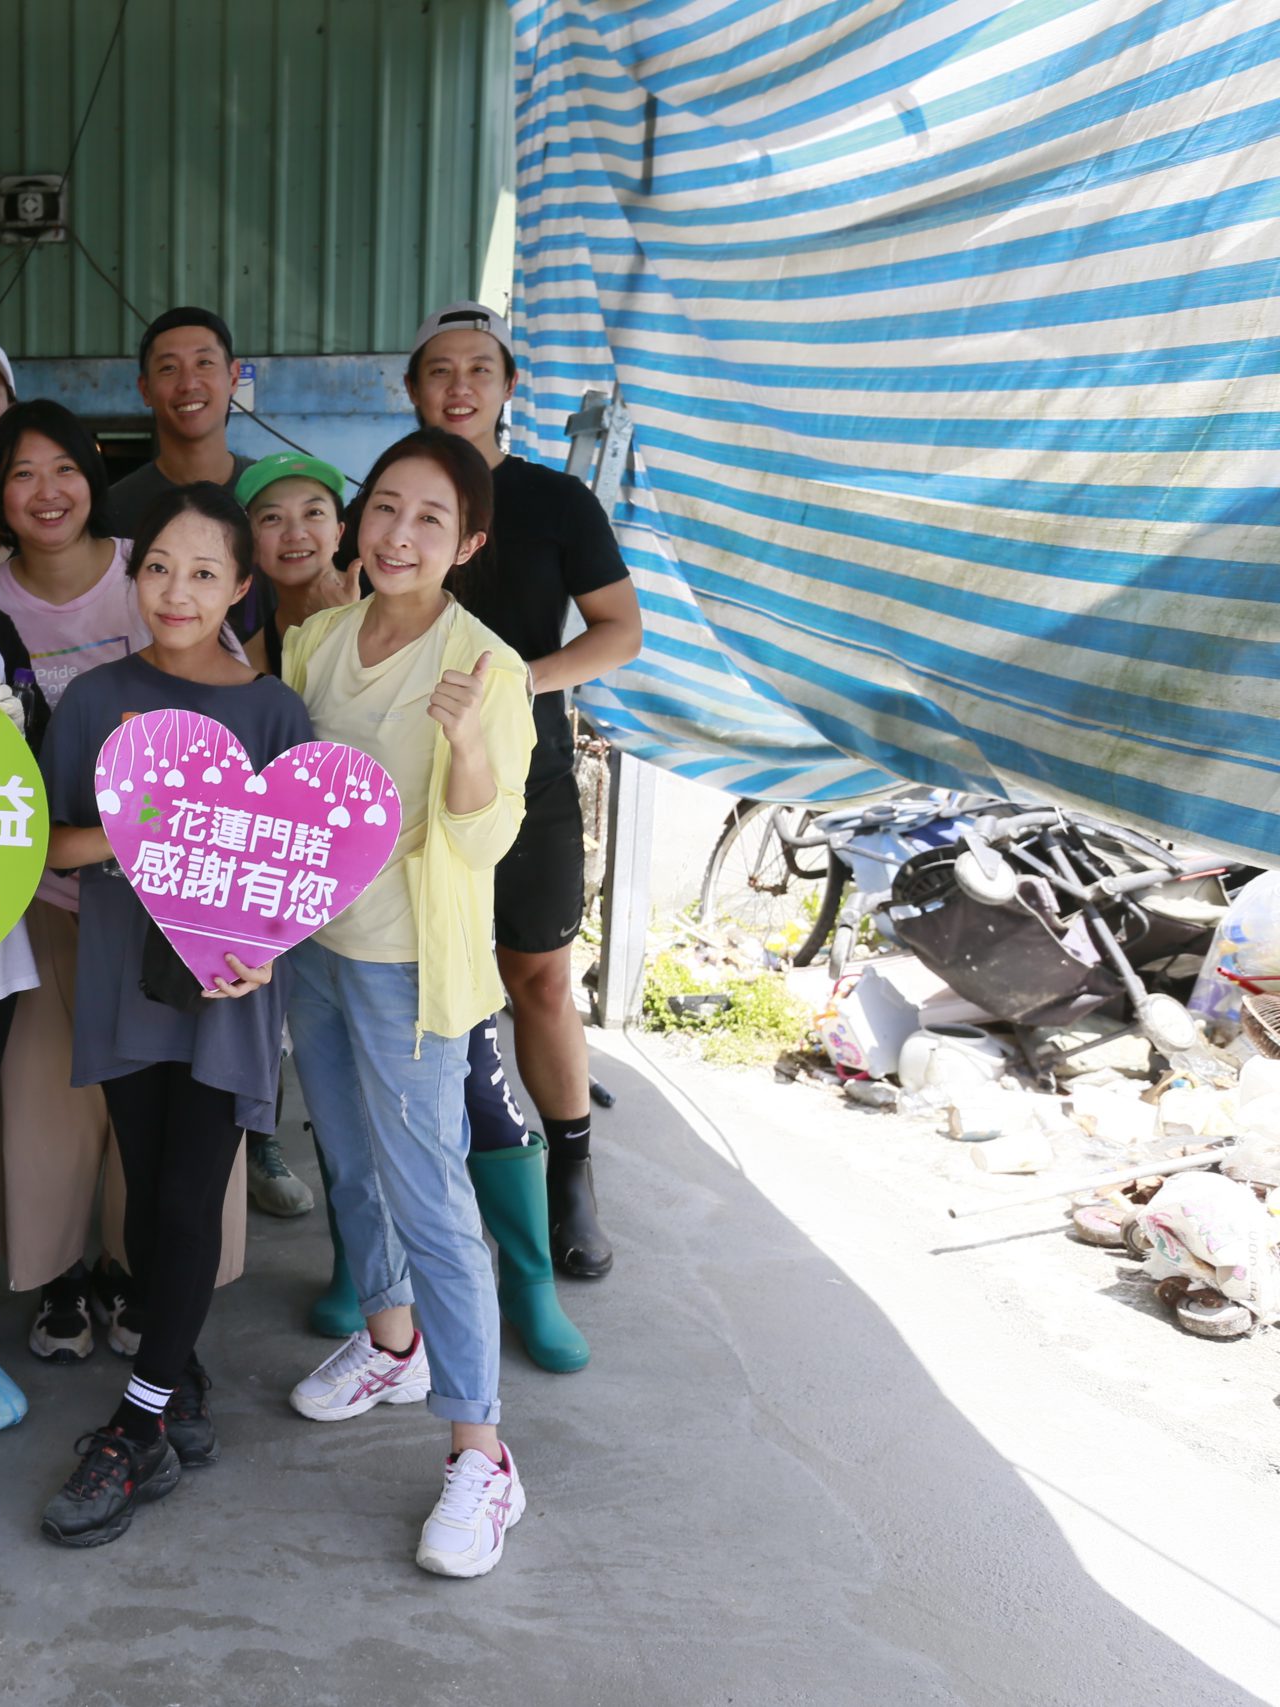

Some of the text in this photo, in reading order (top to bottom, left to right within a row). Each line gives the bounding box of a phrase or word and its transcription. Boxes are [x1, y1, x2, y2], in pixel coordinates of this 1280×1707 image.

[34, 664, 79, 681] Pride
[167, 797, 333, 869] 花蓮門諾
[130, 839, 339, 928] 感謝有您
